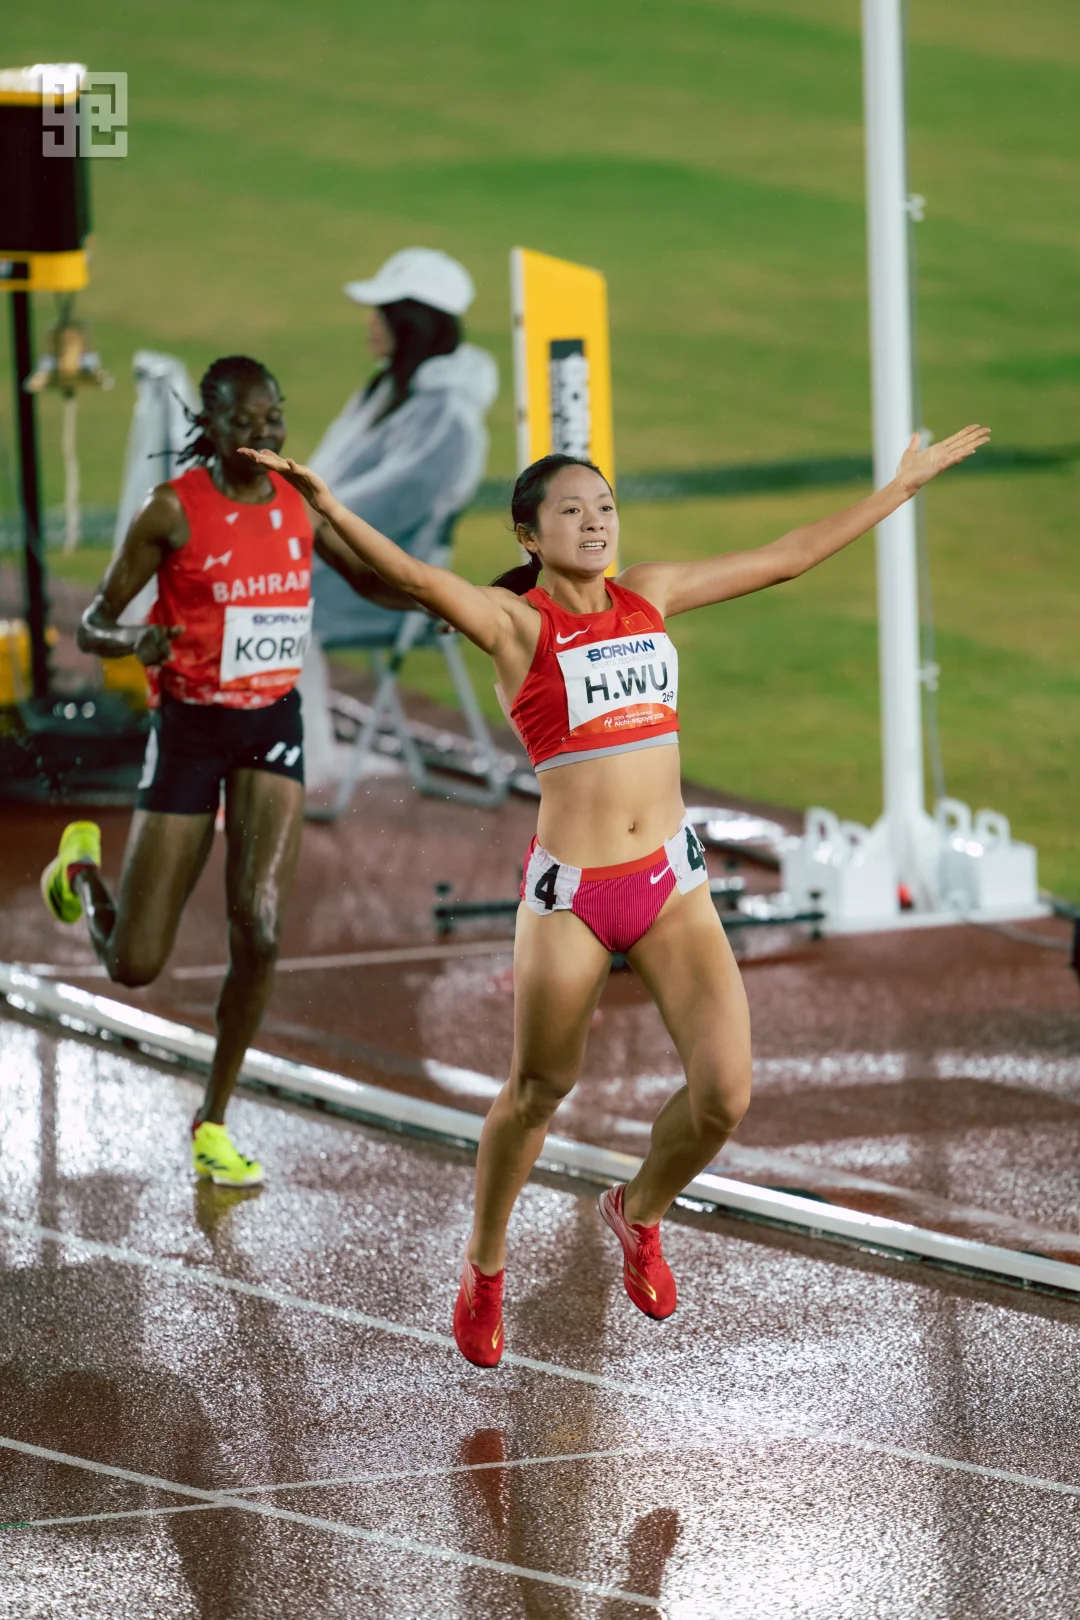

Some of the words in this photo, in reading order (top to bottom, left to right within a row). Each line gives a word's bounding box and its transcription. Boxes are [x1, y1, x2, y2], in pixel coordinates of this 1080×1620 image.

[586, 639, 655, 662] BORNAN
[584, 661, 668, 704] H.WU
[662, 690, 674, 703] 269
[614, 715, 653, 727] Aichi-Nagoya
[684, 825, 707, 872] 4
[534, 863, 561, 911] 4
